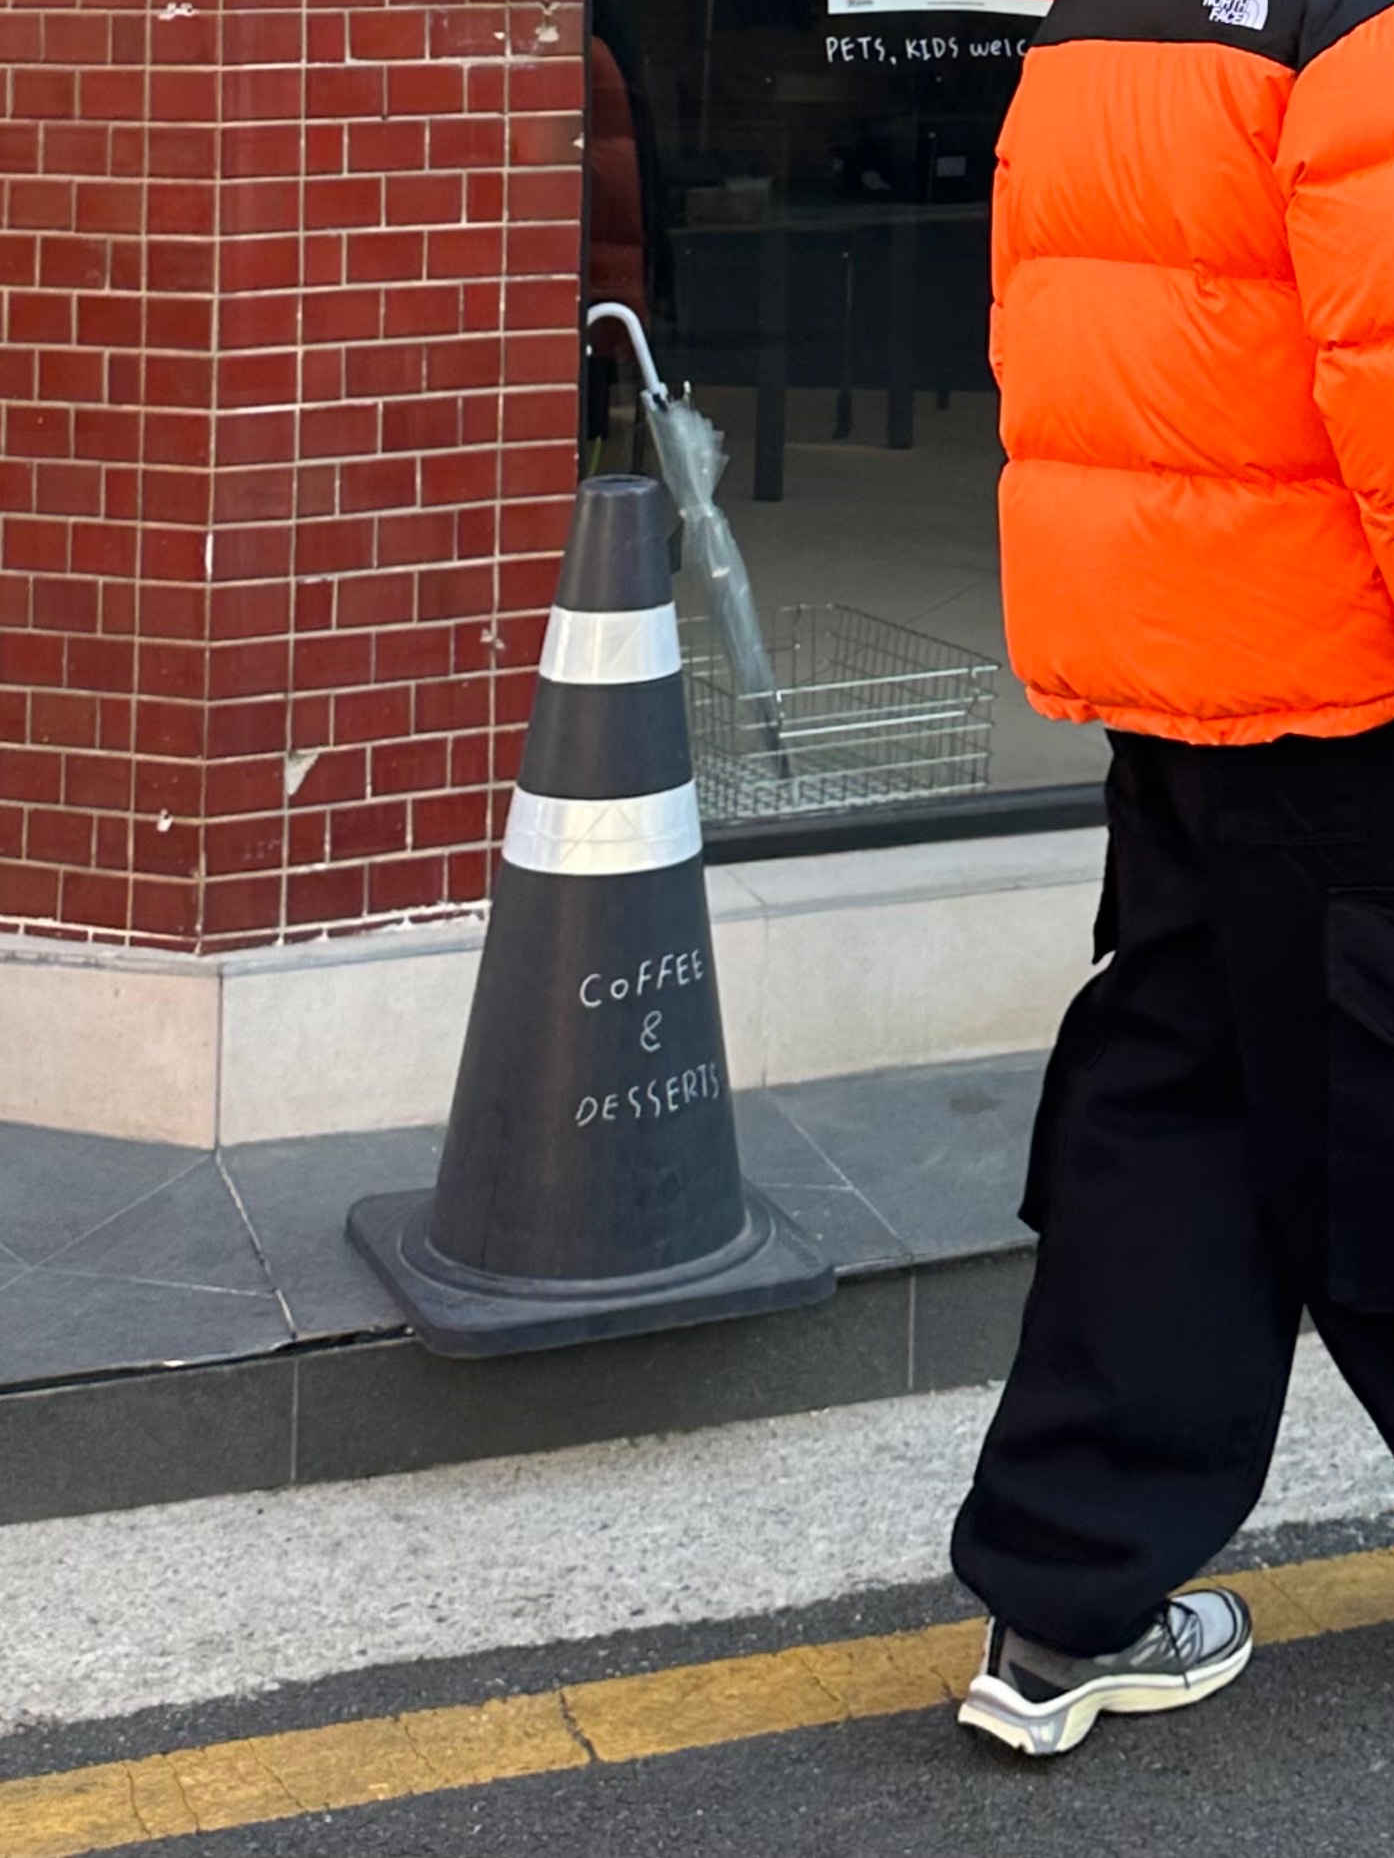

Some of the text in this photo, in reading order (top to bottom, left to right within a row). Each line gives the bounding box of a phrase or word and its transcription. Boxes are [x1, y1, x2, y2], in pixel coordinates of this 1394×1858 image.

[825, 35, 1027, 64] PETS, KIDS welc
[579, 948, 704, 1008] COFFEE
[640, 1009, 663, 1053] &
[575, 1061, 720, 1128] DESSERTS
